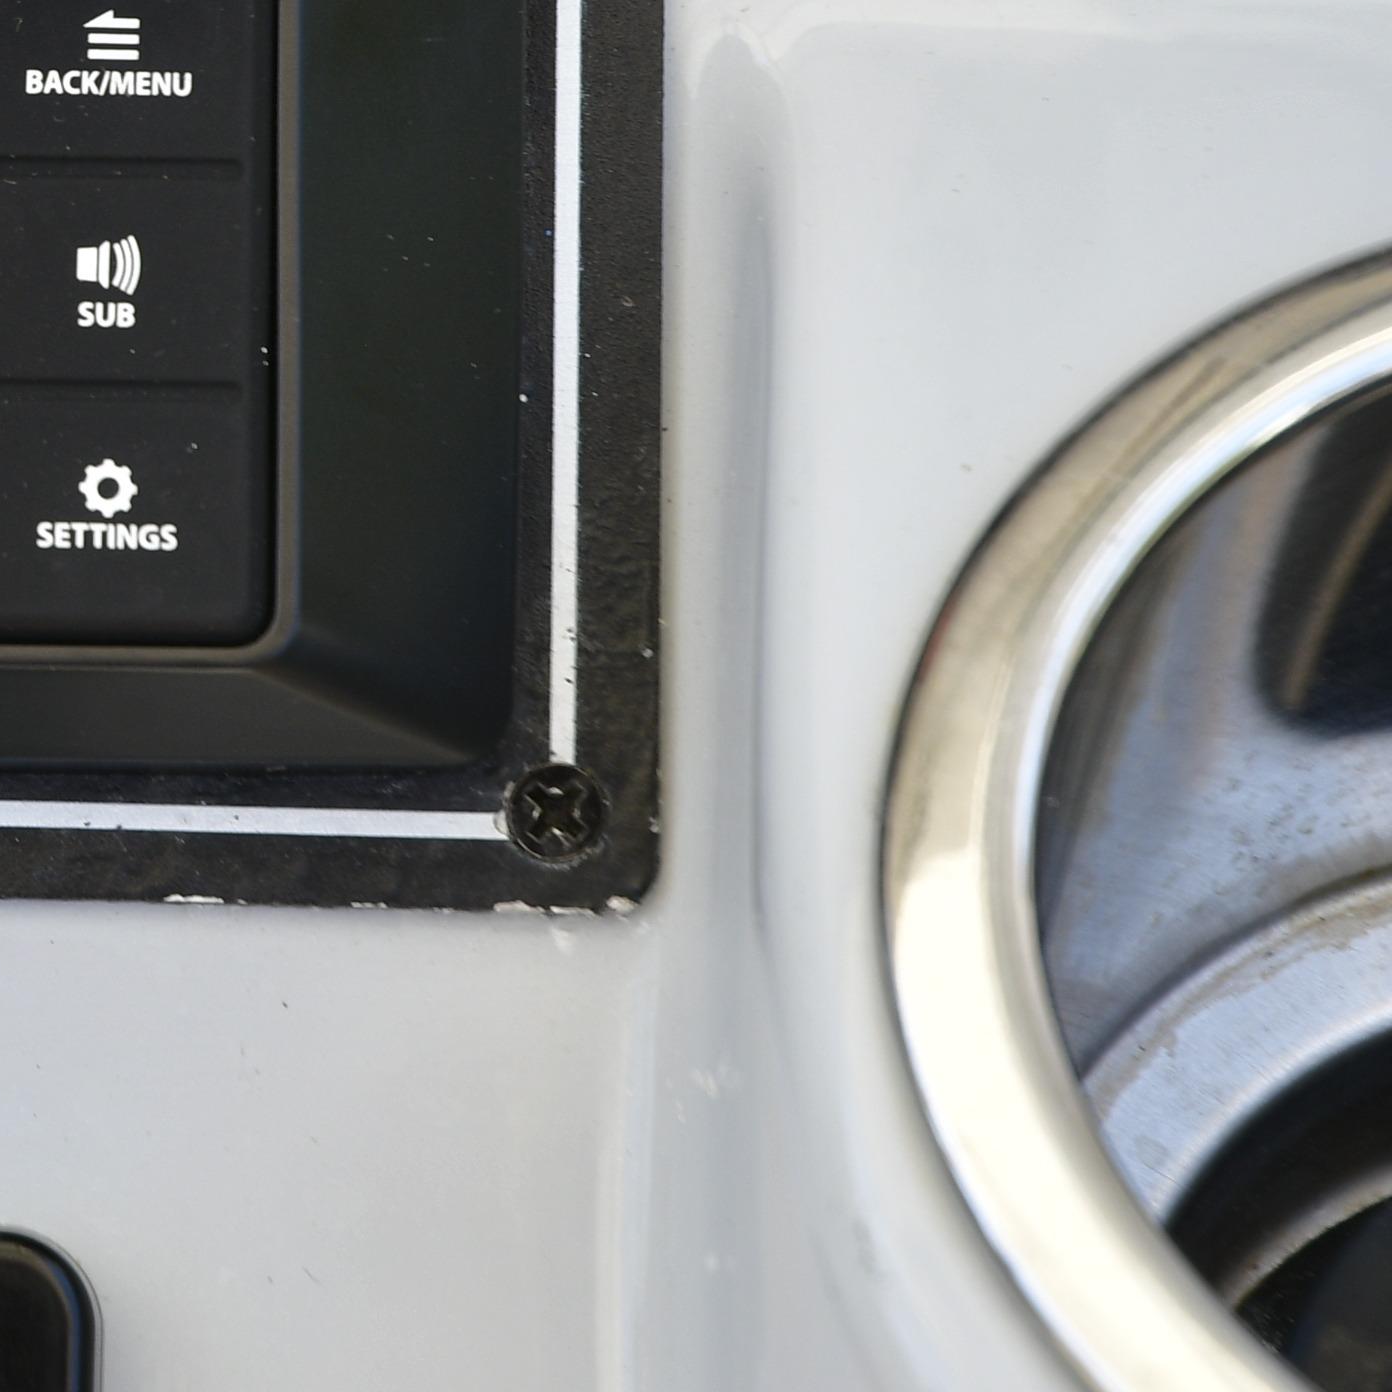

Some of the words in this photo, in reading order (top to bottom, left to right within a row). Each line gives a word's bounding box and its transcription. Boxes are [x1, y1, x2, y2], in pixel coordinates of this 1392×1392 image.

[24, 69, 193, 98] BACK/MENU
[76, 301, 136, 329] SUB
[35, 521, 179, 551] SETTINGS
